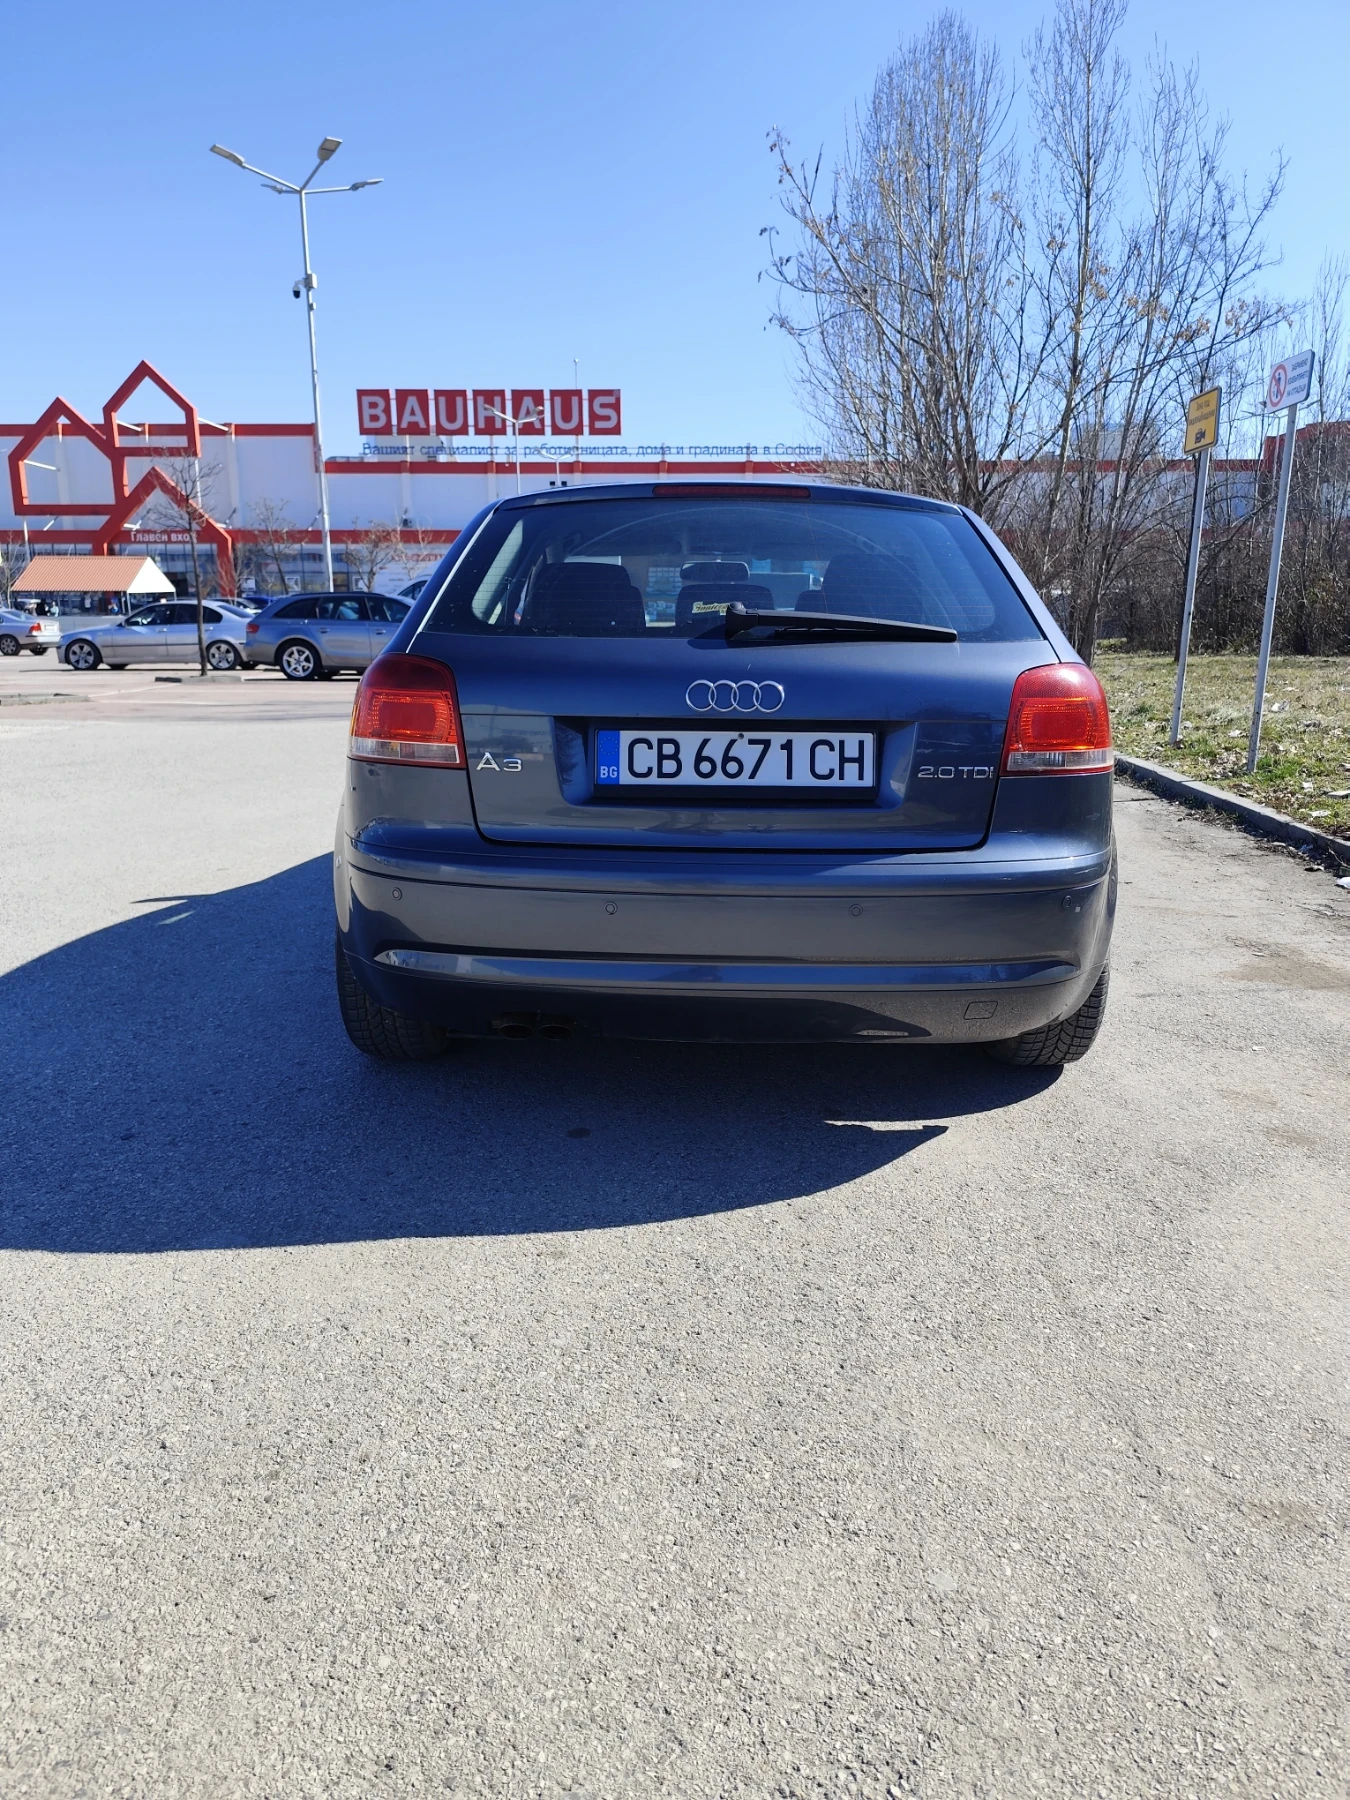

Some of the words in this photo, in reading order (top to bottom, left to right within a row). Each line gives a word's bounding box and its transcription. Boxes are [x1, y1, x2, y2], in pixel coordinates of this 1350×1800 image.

[360, 395, 619, 429] BAUHAUS
[362, 442, 415, 456] Вашият
[636, 445, 672, 457] дома
[676, 445, 684, 455] и
[688, 445, 758, 458] градината
[763, 445, 771, 455] в
[775, 442, 822, 456] София
[130, 531, 169, 543] Главен
[476, 751, 522, 772] A3
[627, 737, 683, 779] CB
[693, 738, 793, 780] 6671
[809, 739, 865, 781] CH
[600, 765, 618, 778] BG
[917, 765, 955, 779] 2.0
[958, 766, 995, 779] TDI
